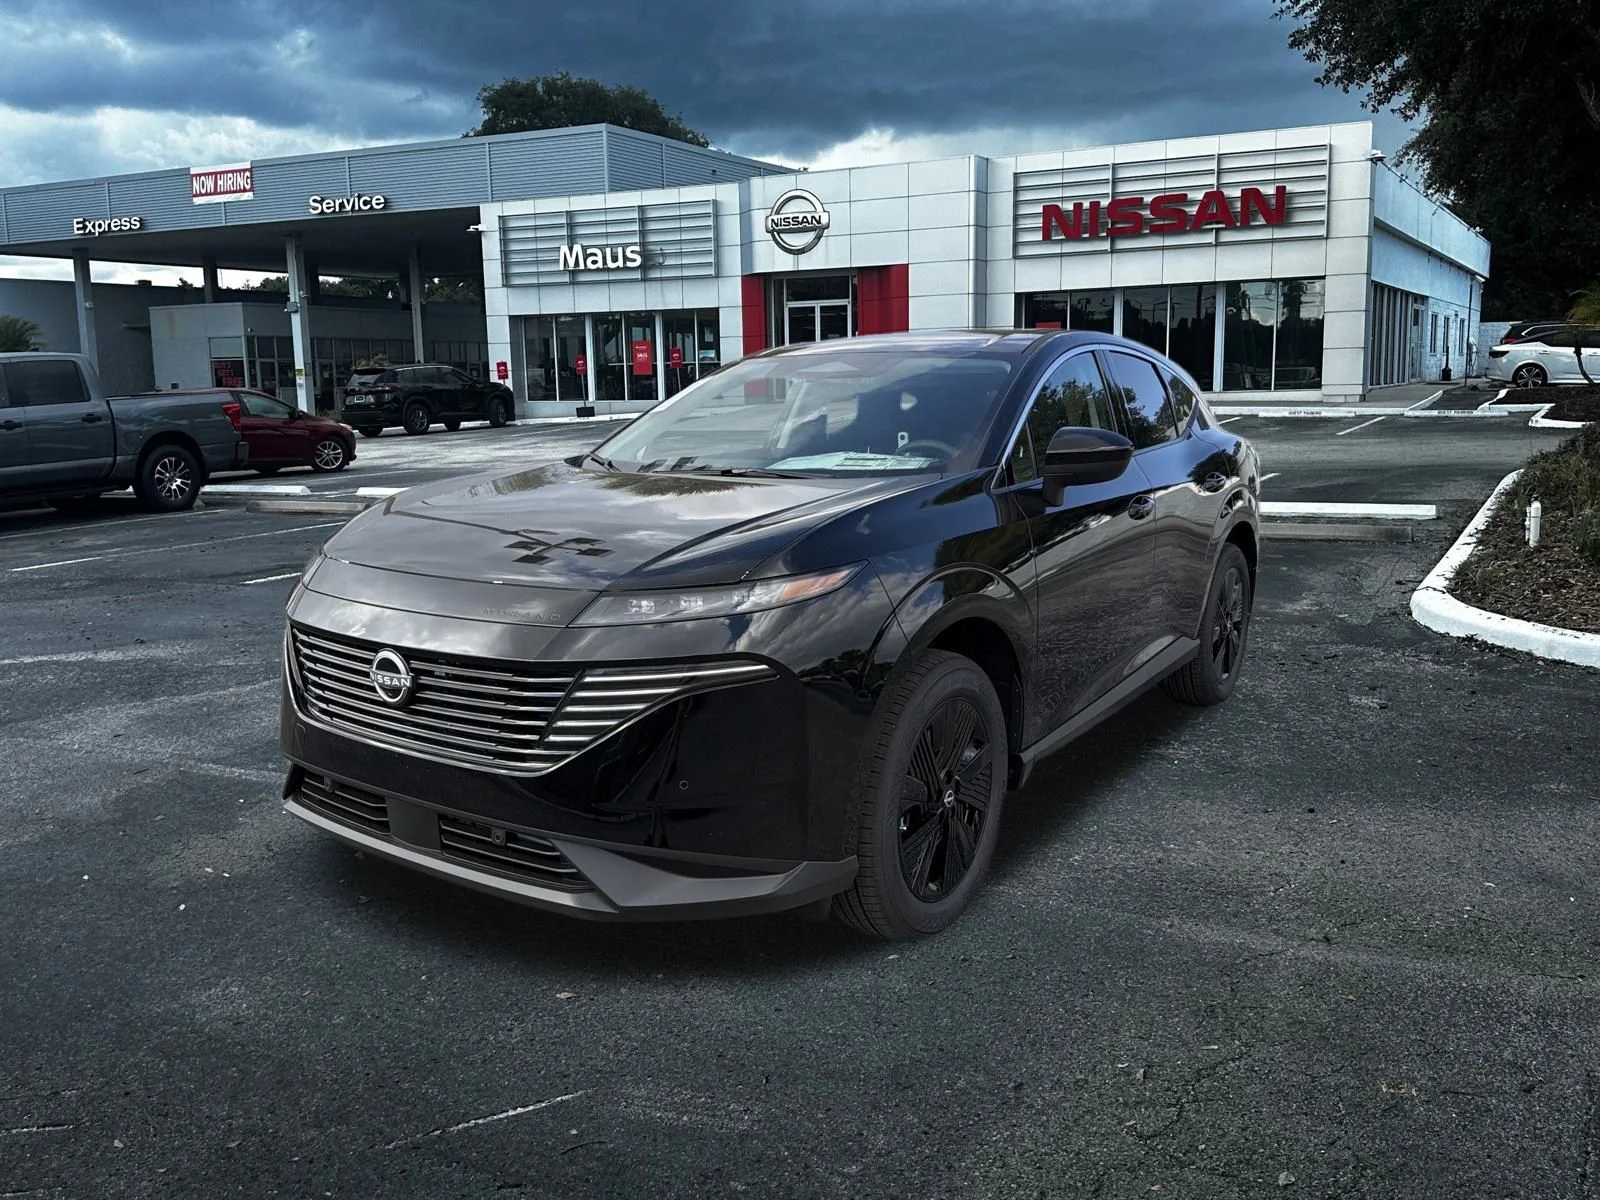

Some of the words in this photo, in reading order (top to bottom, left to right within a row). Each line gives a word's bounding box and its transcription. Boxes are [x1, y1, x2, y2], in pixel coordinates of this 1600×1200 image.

[192, 174, 216, 195] NOW
[217, 170, 251, 192] HIRING
[308, 192, 385, 215] Service
[1042, 184, 1287, 241] NISSAN
[73, 216, 141, 237] Express
[770, 214, 822, 228] NISSAN
[559, 243, 642, 271] Maus
[370, 671, 410, 687] NISSAN
